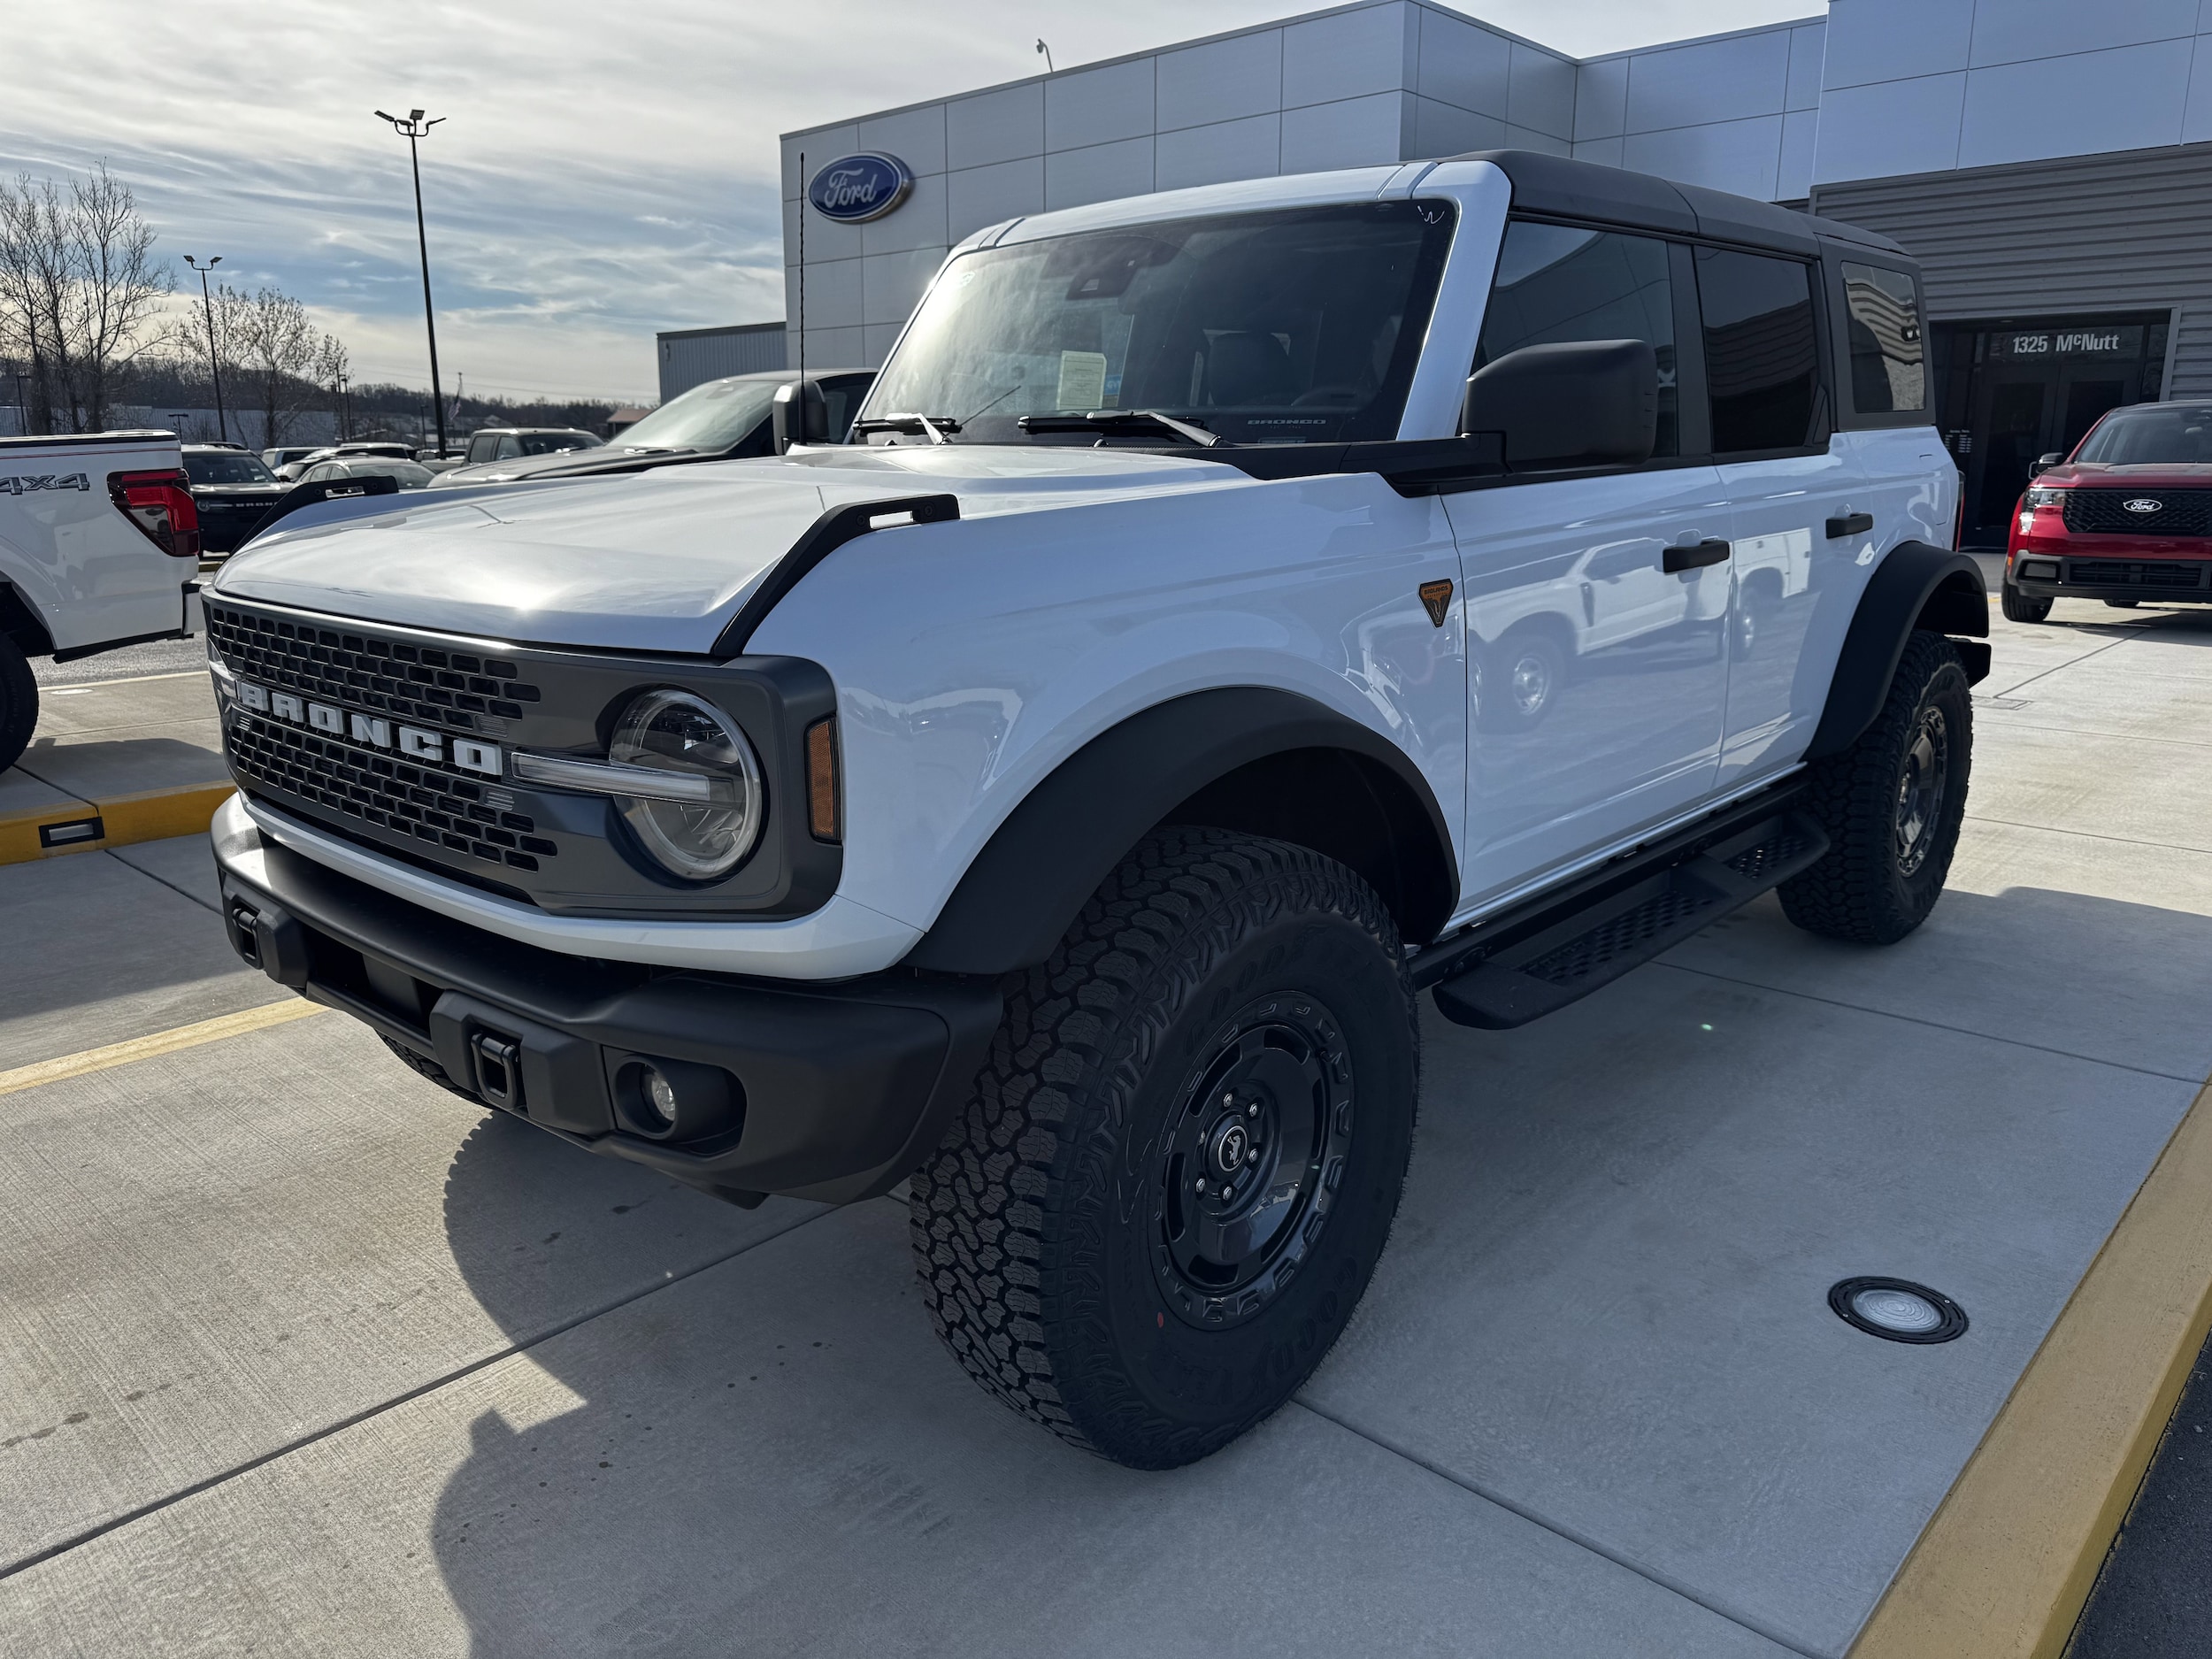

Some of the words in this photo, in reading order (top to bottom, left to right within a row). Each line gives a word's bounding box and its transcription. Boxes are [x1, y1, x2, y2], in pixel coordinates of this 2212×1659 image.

[824, 167, 879, 209] Ford
[2012, 335, 2048, 354] 1325
[2055, 334, 2120, 352] McNutt
[2130, 501, 2155, 511] Ford
[241, 680, 503, 776] BRONCO
